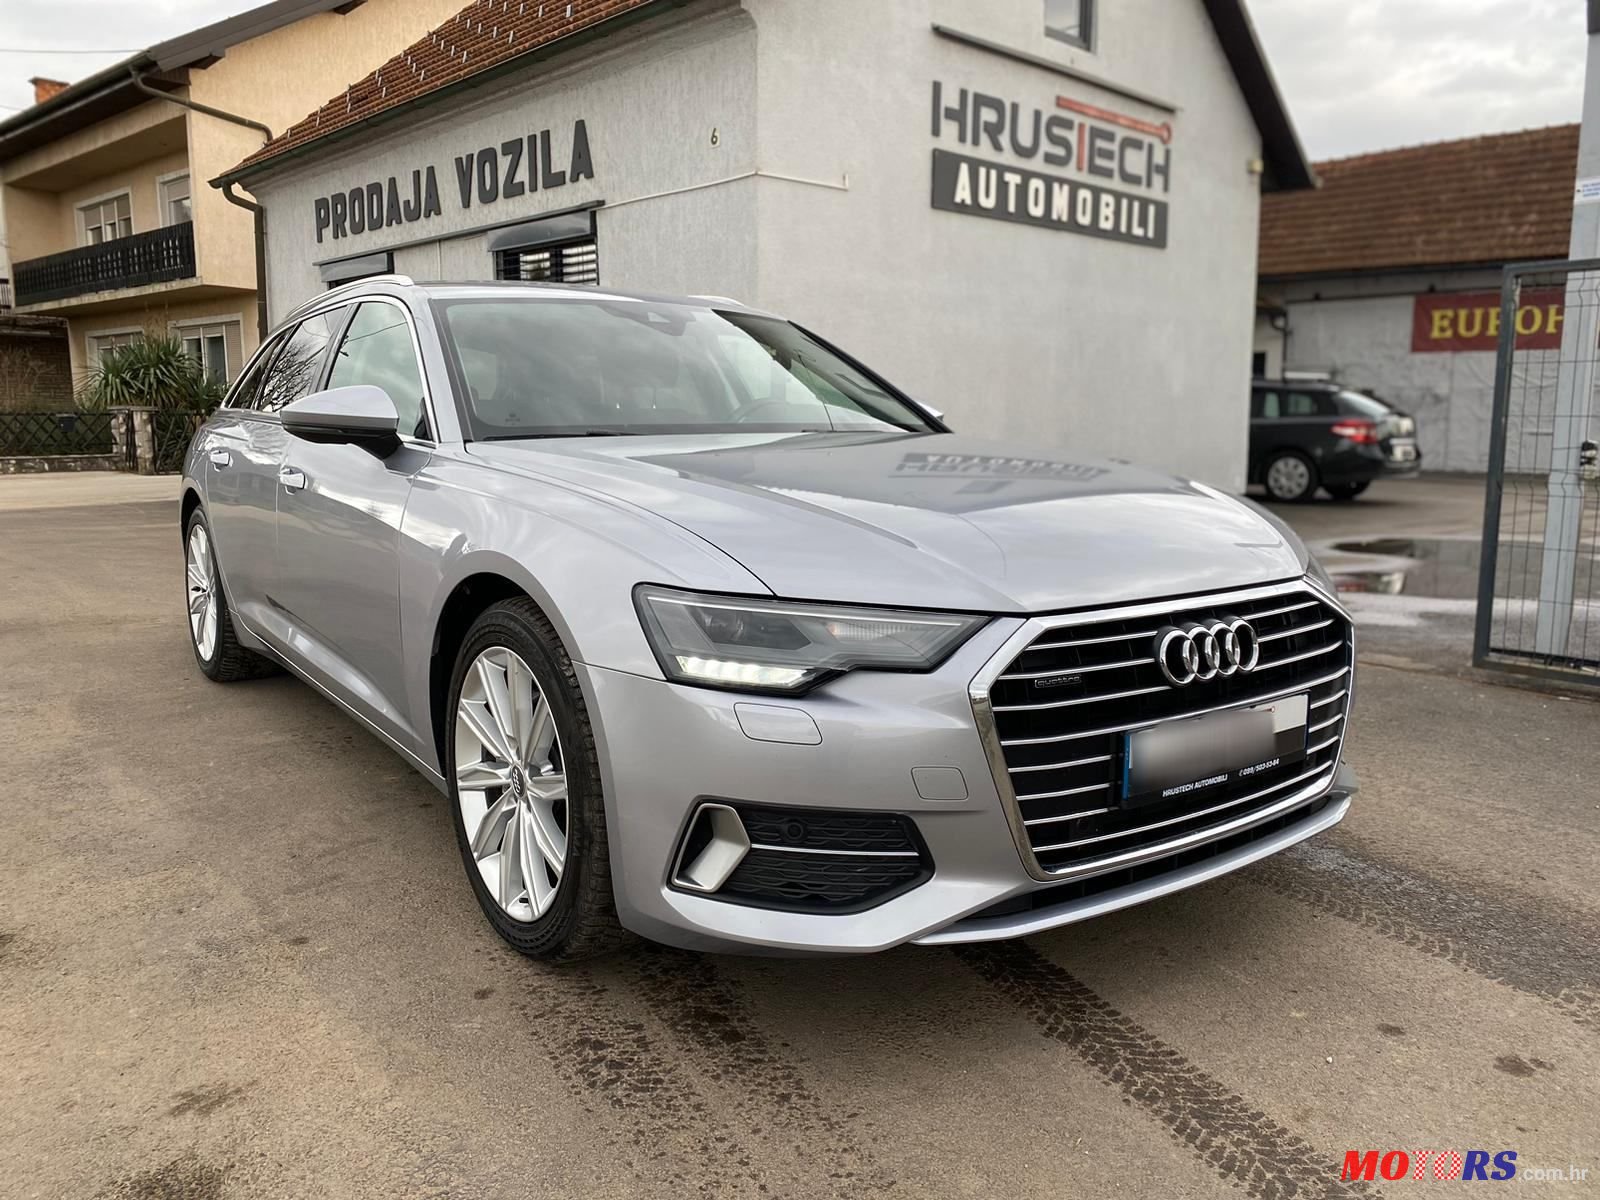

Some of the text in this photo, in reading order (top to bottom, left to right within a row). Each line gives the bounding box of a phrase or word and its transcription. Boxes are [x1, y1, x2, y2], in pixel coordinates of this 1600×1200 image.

[710, 127, 718, 145] 6
[931, 80, 1171, 193] HRUSTECH
[314, 119, 594, 243] PRODAJA VOZILA
[954, 162, 1155, 239] AUTOMOBILI
[1162, 774, 1228, 798] HRUSTECH AUTOMOBILI
